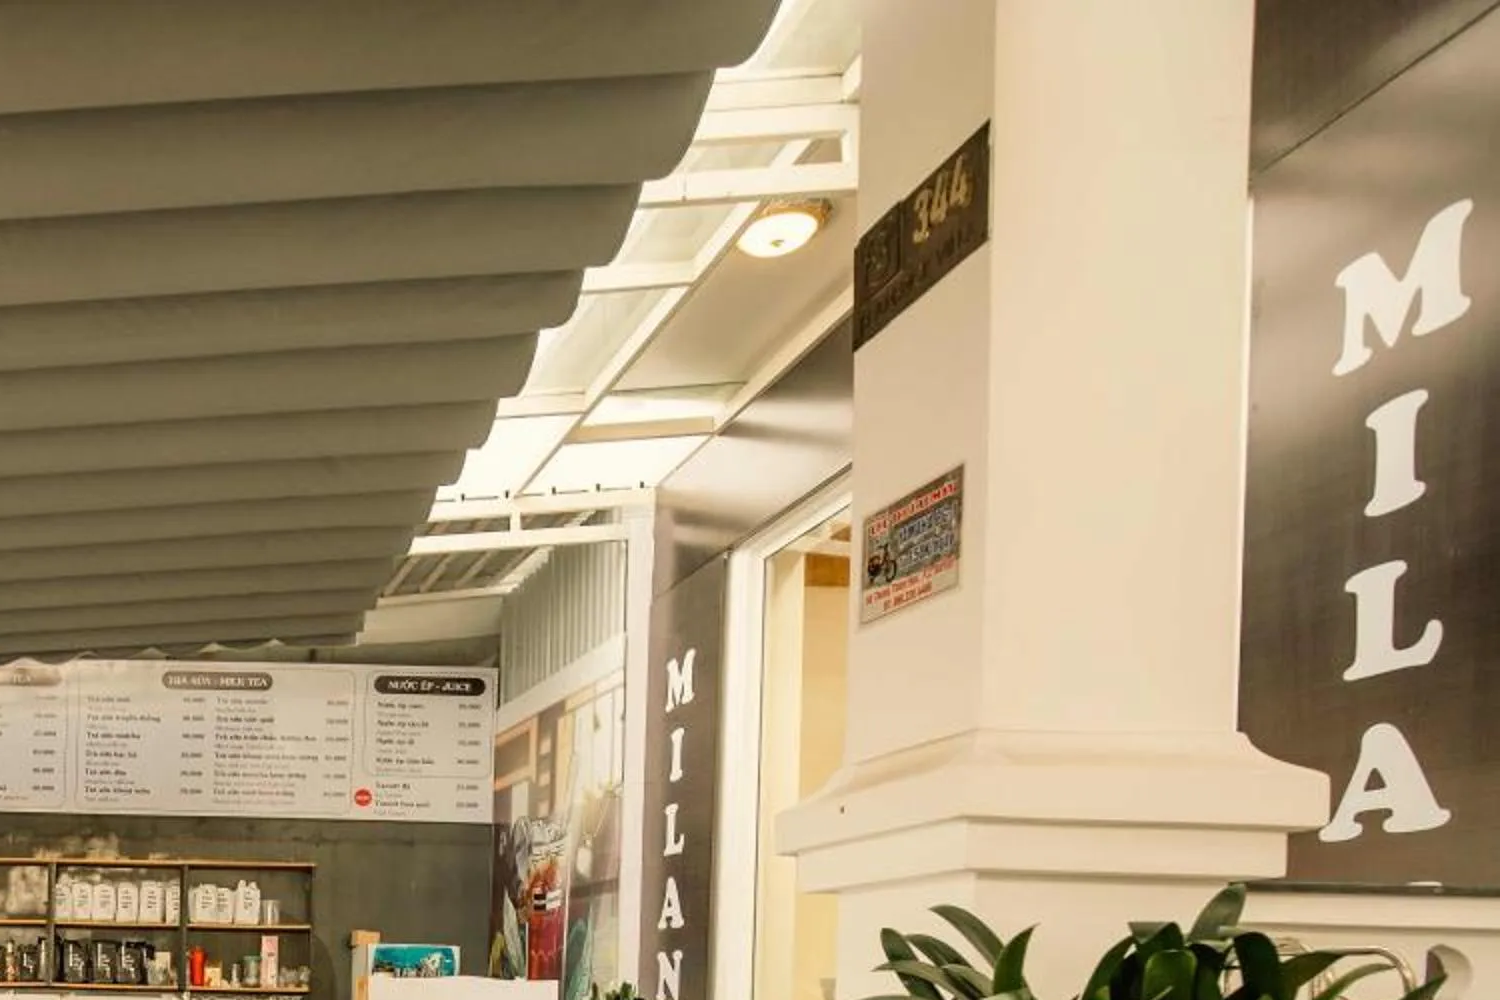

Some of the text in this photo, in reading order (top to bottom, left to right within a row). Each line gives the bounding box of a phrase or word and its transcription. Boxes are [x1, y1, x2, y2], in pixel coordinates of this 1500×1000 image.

[912, 154, 974, 246] 344
[1319, 198, 1472, 886] MILA
[248, 677, 268, 687] TEA
[442, 681, 472, 692] JUICE
